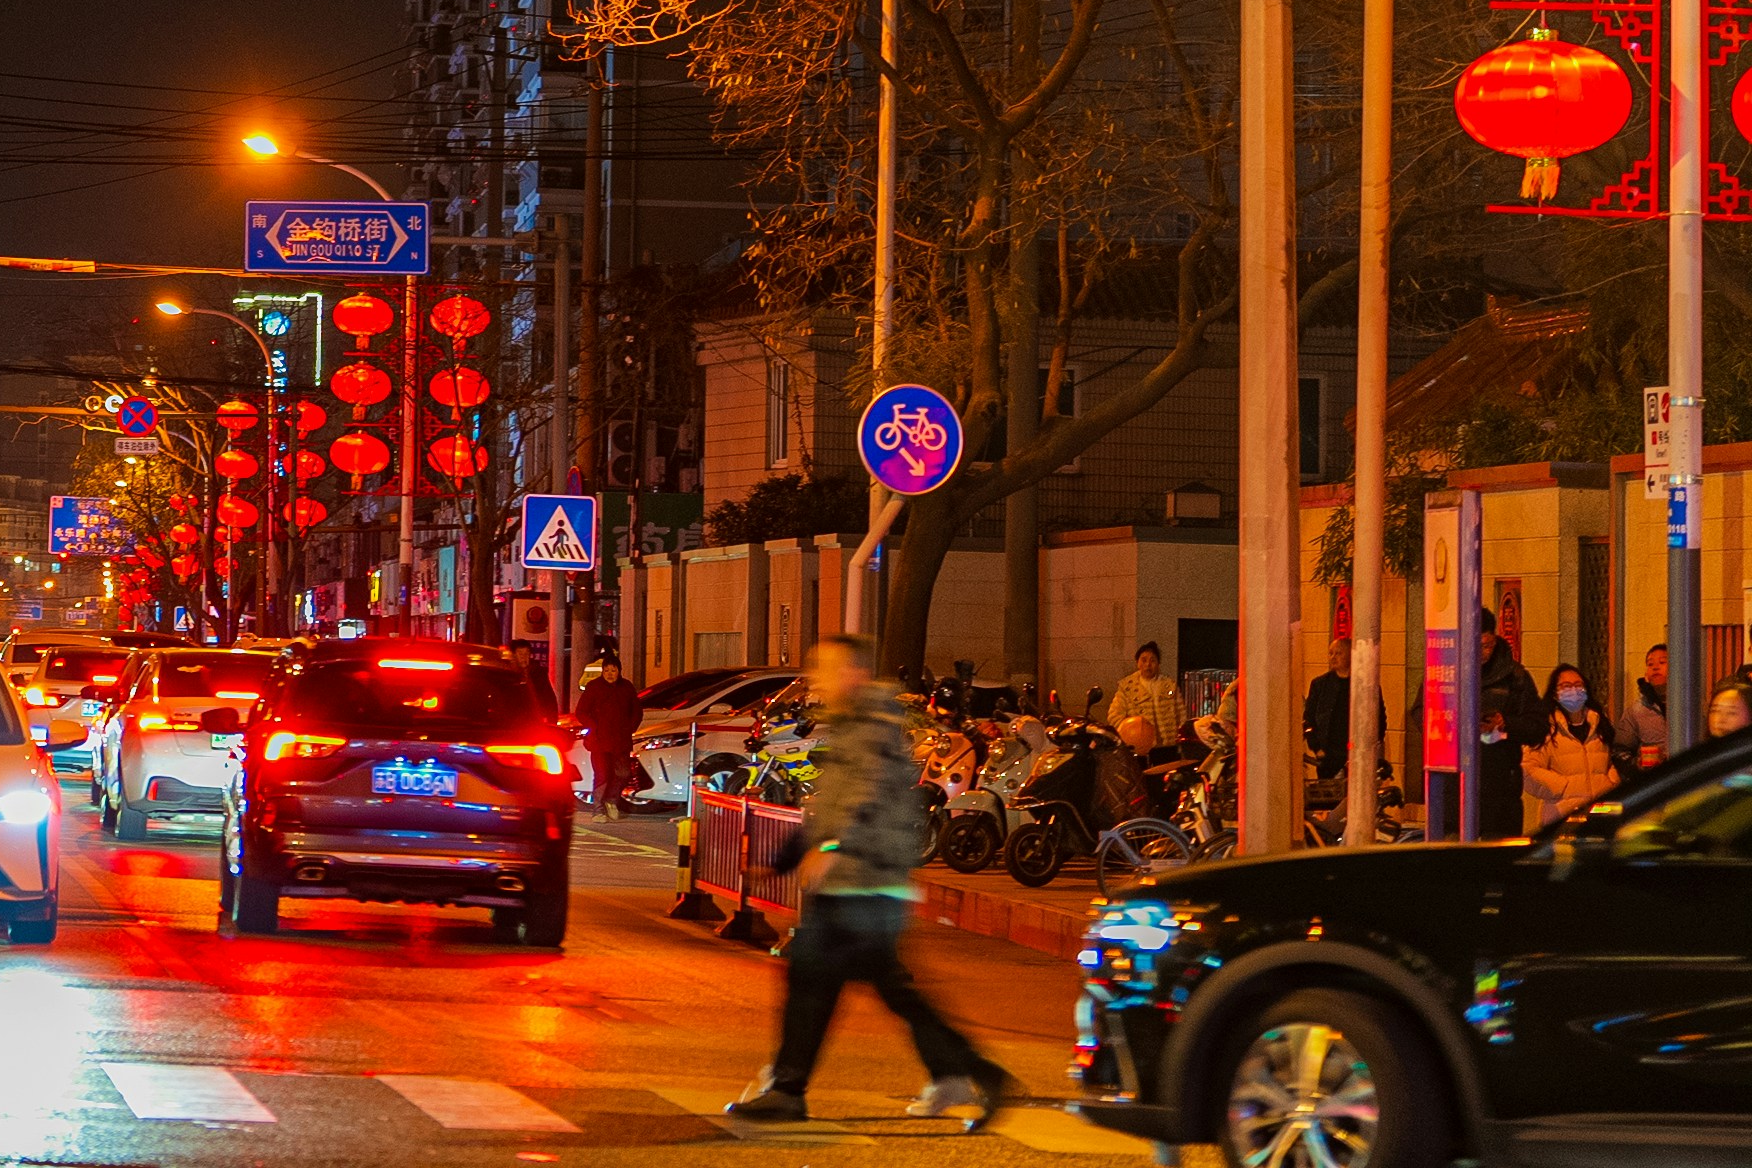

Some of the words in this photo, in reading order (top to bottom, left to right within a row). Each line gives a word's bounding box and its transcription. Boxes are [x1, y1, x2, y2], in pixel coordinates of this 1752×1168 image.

[252, 214, 267, 229] 南
[407, 216, 422, 231] 北
[287, 218, 389, 242] 金钩桥街
[257, 250, 264, 258] S
[411, 252, 418, 260] N
